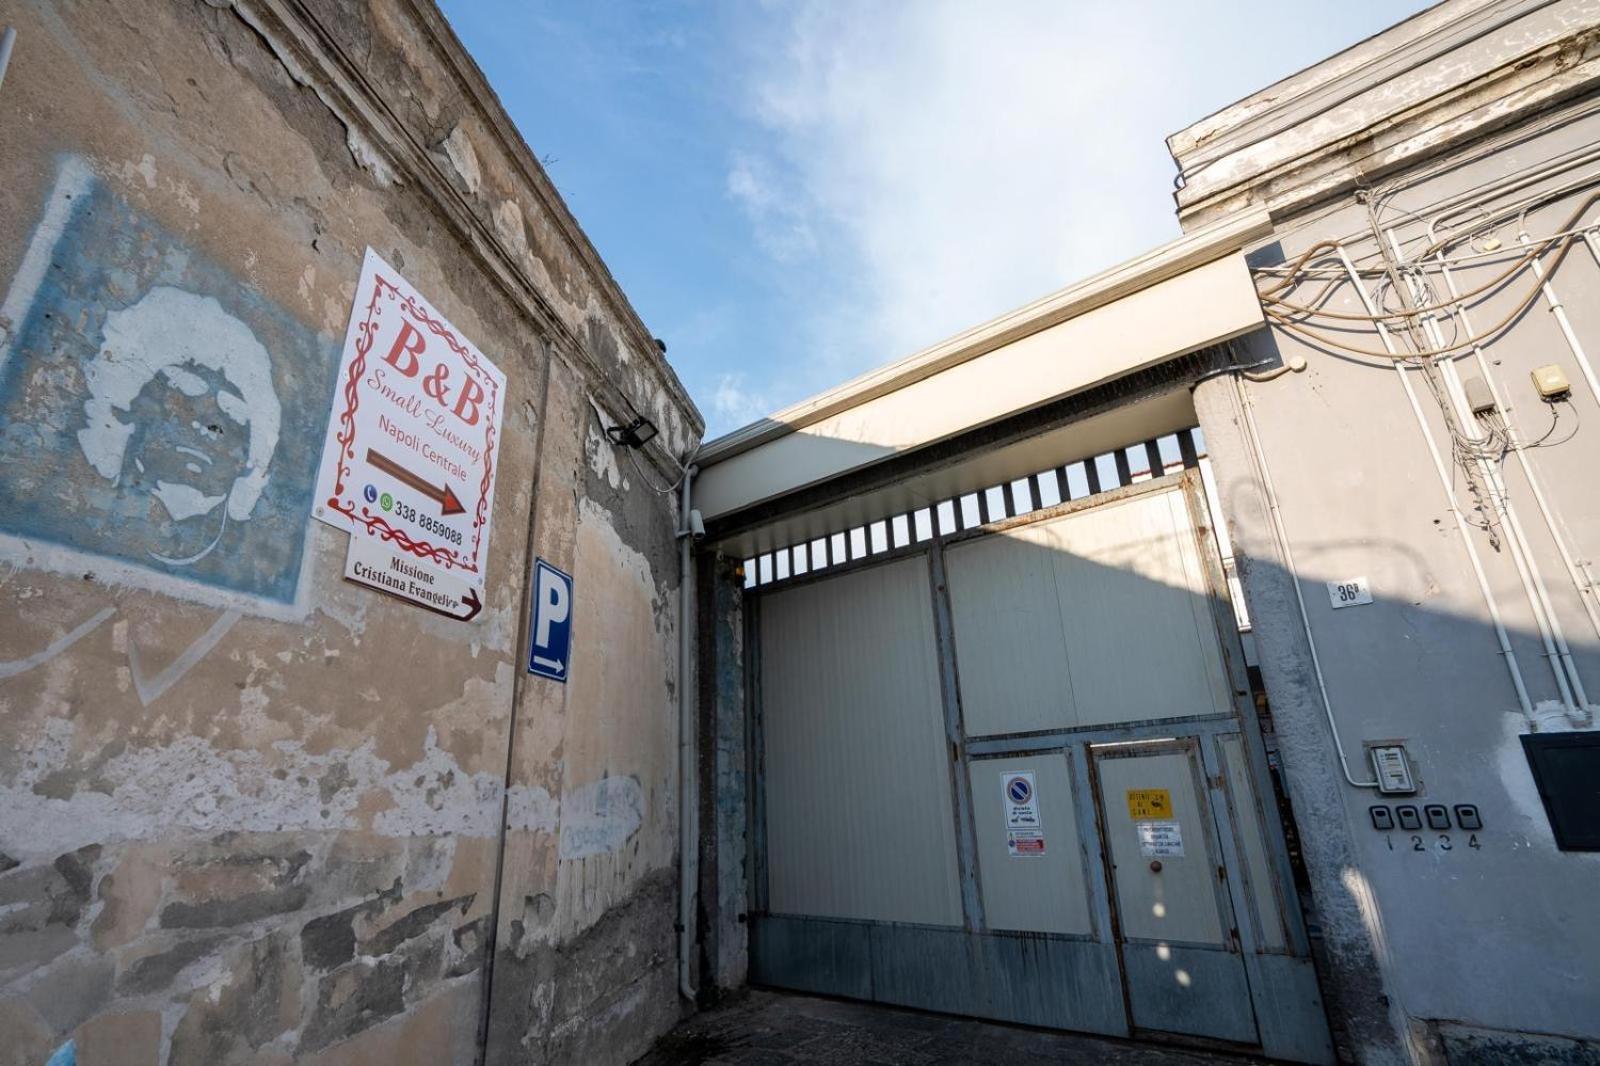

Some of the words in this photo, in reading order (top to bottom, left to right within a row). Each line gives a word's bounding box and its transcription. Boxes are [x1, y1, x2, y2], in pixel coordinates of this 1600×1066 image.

[380, 316, 484, 426] B&B
[367, 368, 424, 418] Small
[424, 408, 481, 465] Luxury
[379, 414, 420, 452] Napoli
[421, 443, 468, 482] Centrale
[395, 500, 416, 522] 338
[418, 515, 463, 546] 8859088
[353, 561, 406, 592] Cristiana
[390, 556, 435, 585] Missione
[536, 566, 570, 649] P
[1385, 834, 1393, 851] 1
[1411, 835, 1425, 851] 2
[1439, 834, 1454, 851] 3
[1468, 833, 1481, 850] 4
